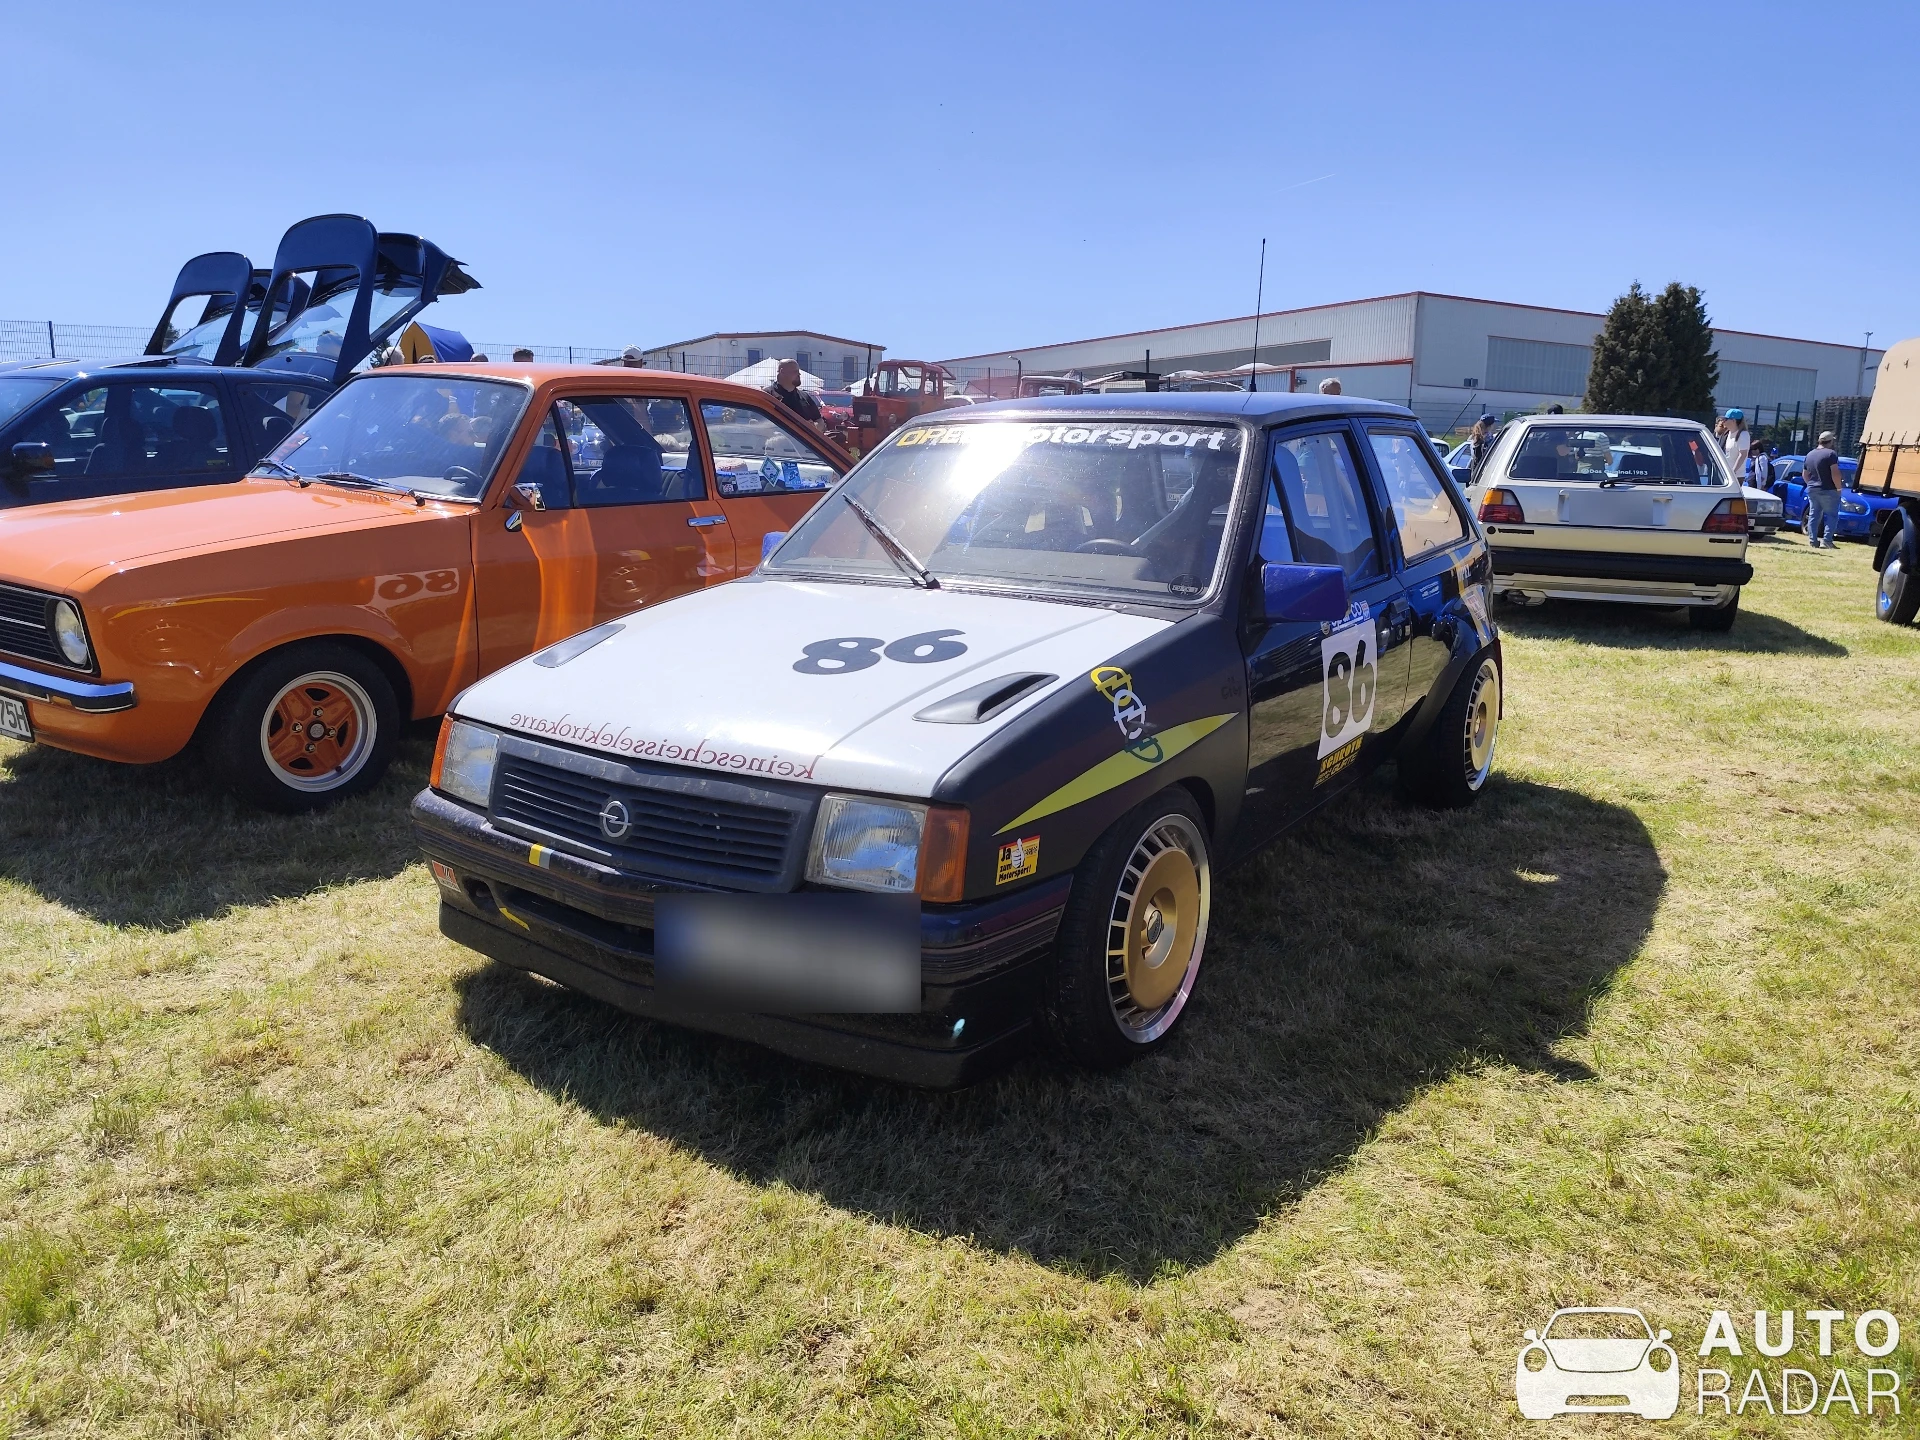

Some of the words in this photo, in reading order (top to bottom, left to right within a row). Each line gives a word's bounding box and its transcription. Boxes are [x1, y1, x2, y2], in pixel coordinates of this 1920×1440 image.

[988, 426, 1227, 451] otorsport
[792, 628, 968, 676] 86
[1324, 639, 1375, 739] 86
[1001, 847, 1012, 862] Ja
[998, 864, 1032, 883] Motorsport!
